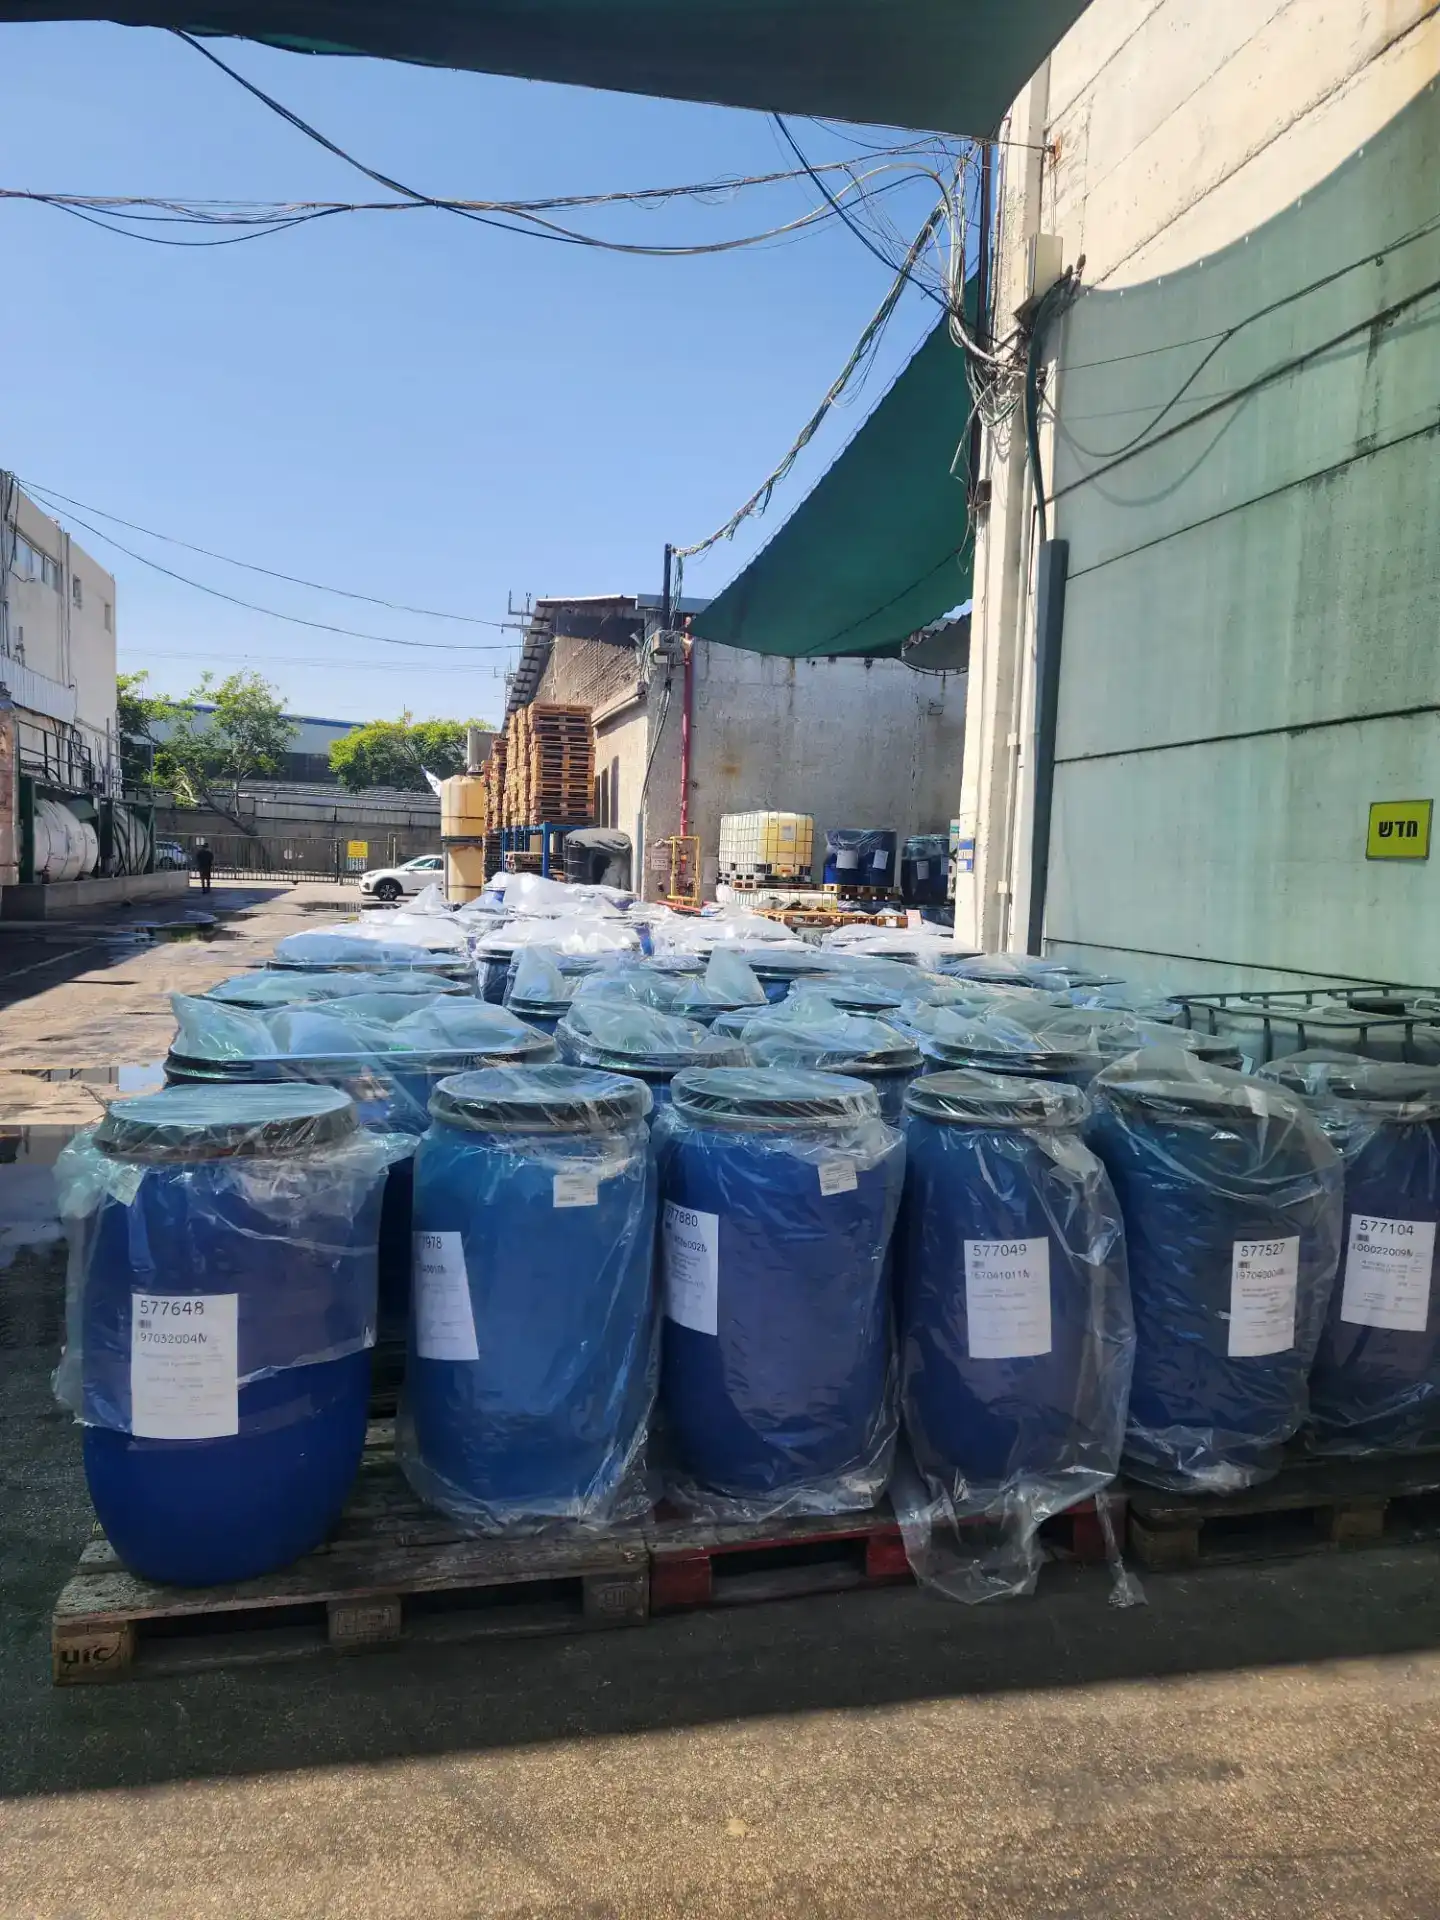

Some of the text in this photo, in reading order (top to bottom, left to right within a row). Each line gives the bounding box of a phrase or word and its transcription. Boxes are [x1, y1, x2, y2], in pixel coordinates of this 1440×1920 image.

[1379, 820, 1418, 838] חדש
[1360, 1220, 1415, 1236] 577104
[973, 1244, 1028, 1257] 577049
[1241, 1243, 1285, 1257] 577527
[140, 1300, 205, 1316] 577648
